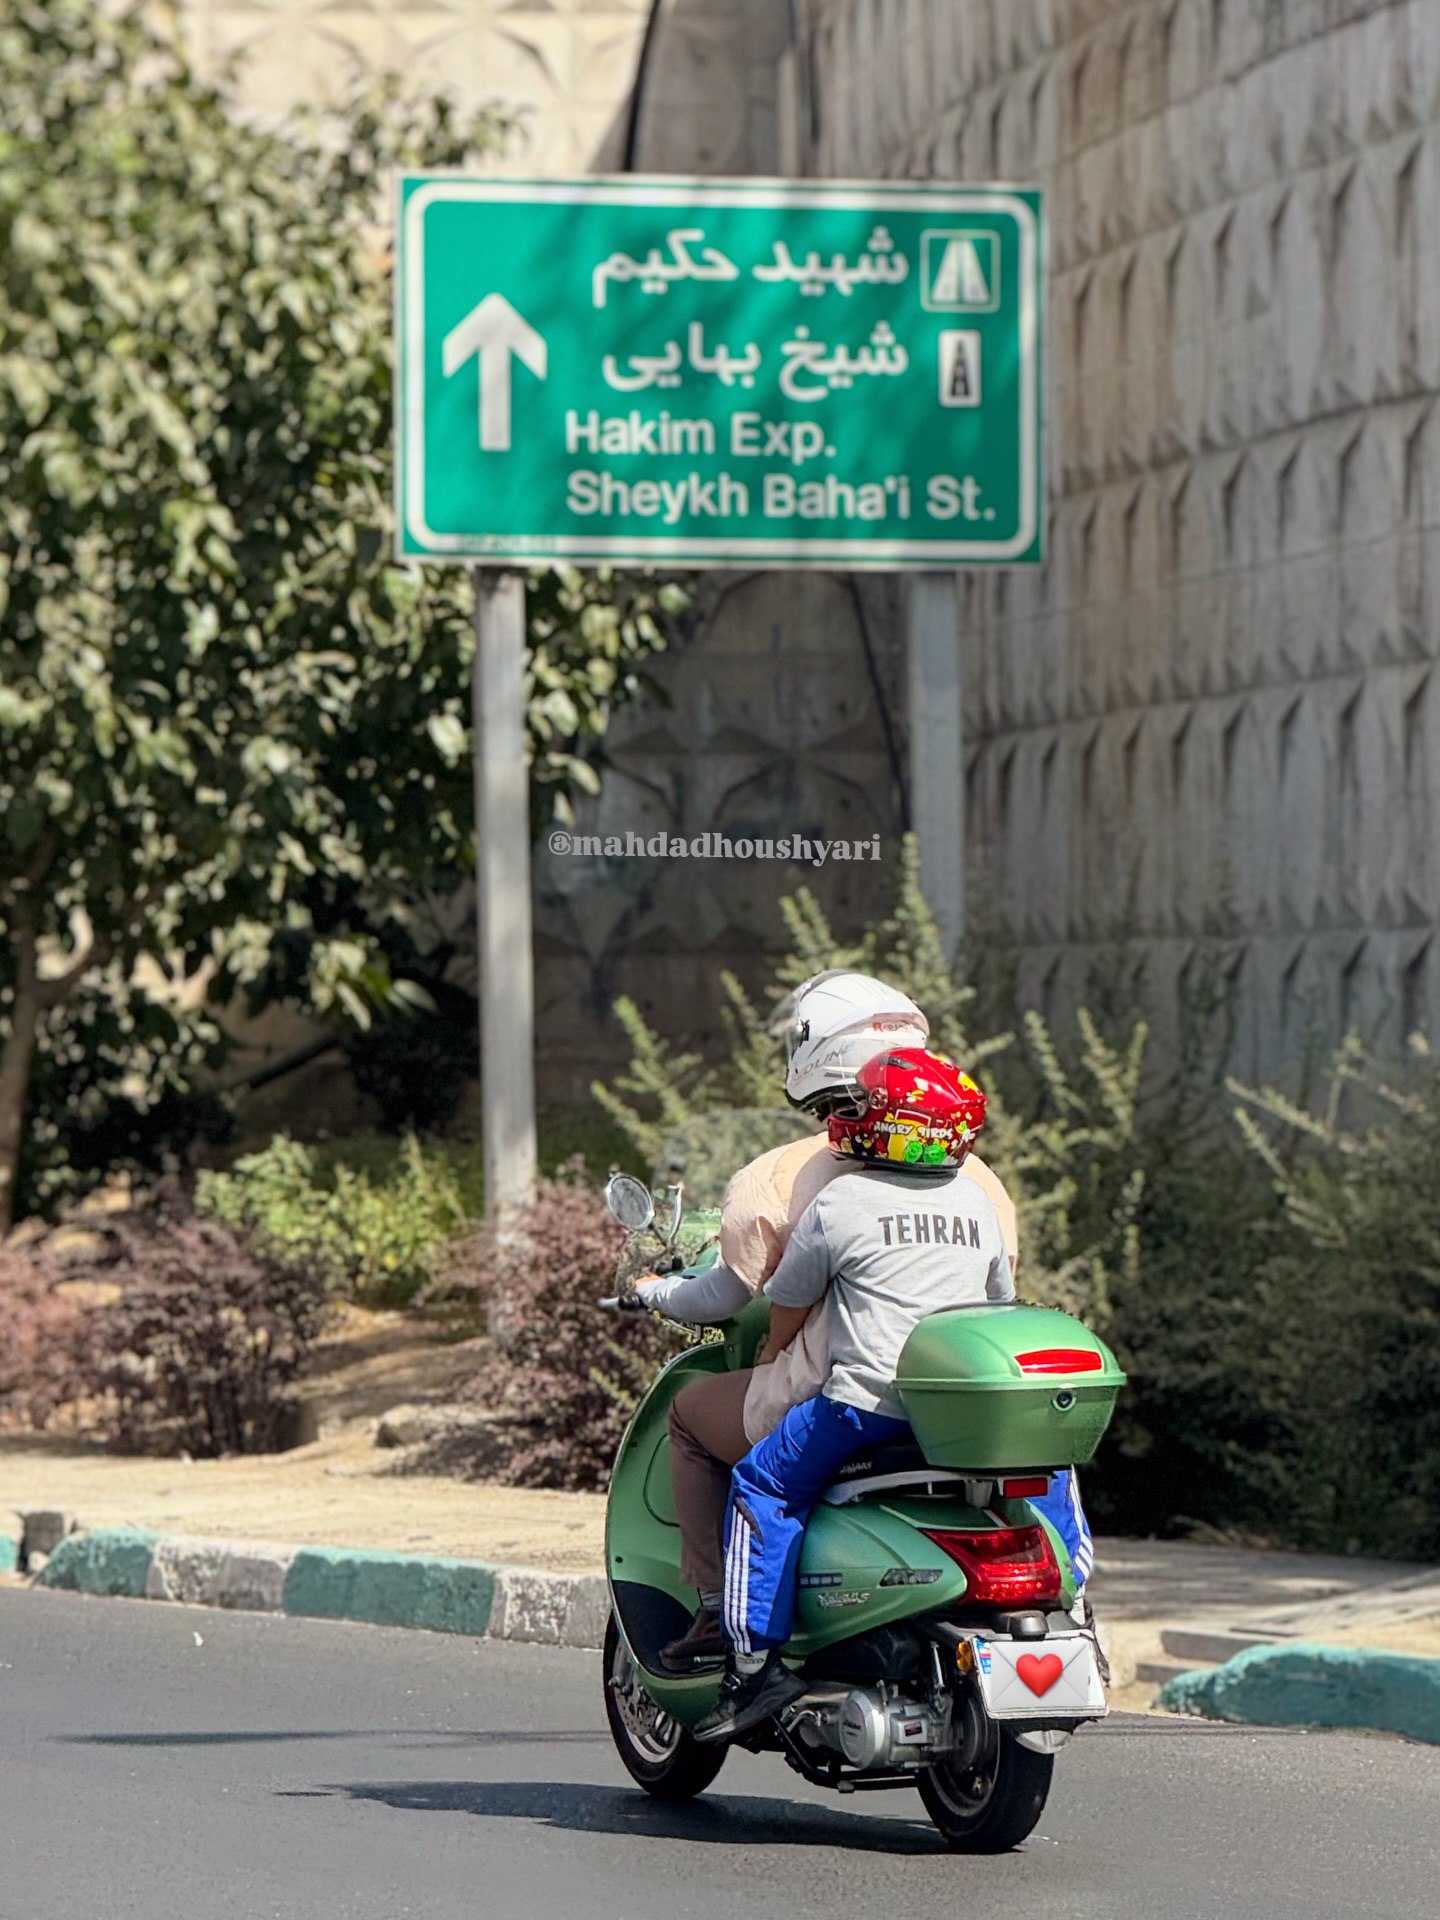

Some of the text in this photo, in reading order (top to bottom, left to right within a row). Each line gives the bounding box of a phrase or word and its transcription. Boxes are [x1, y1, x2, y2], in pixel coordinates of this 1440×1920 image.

[591, 226, 909, 309] شهید حکیم
[602, 320, 909, 402] شیخ بهایی
[565, 409, 836, 465] Hakim Exp.
[567, 470, 997, 525] Sheykh Baha'i St.
[873, 1121, 914, 1135] ANGRY
[877, 1213, 981, 1250] TEHRAN
